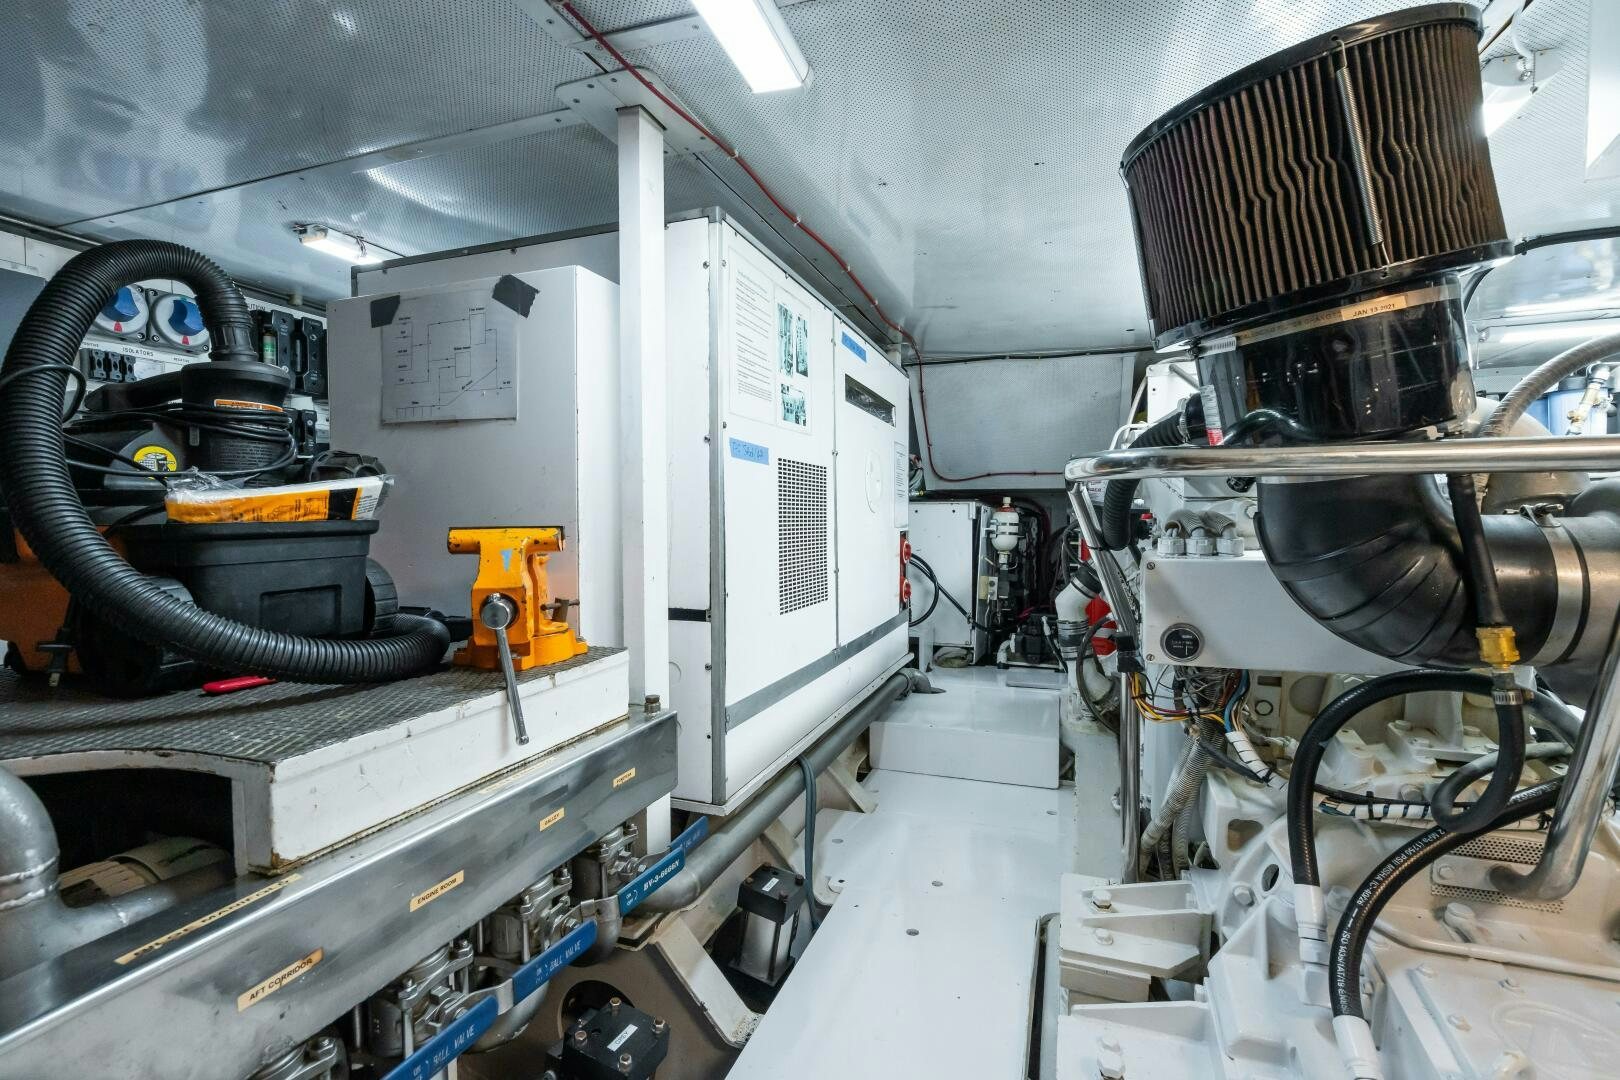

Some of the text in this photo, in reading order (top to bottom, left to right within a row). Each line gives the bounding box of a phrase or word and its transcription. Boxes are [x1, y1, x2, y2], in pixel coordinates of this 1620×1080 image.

[1353, 309, 1367, 317] JAN
[1380, 303, 1395, 311] 2021
[122, 347, 154, 357] ISOLATORS
[1375, 863, 1395, 881] MSHA
[417, 877, 457, 905] ENGINE ROOM
[1341, 931, 1351, 944] ISO
[249, 957, 313, 1001] AFT CORRIDOR
